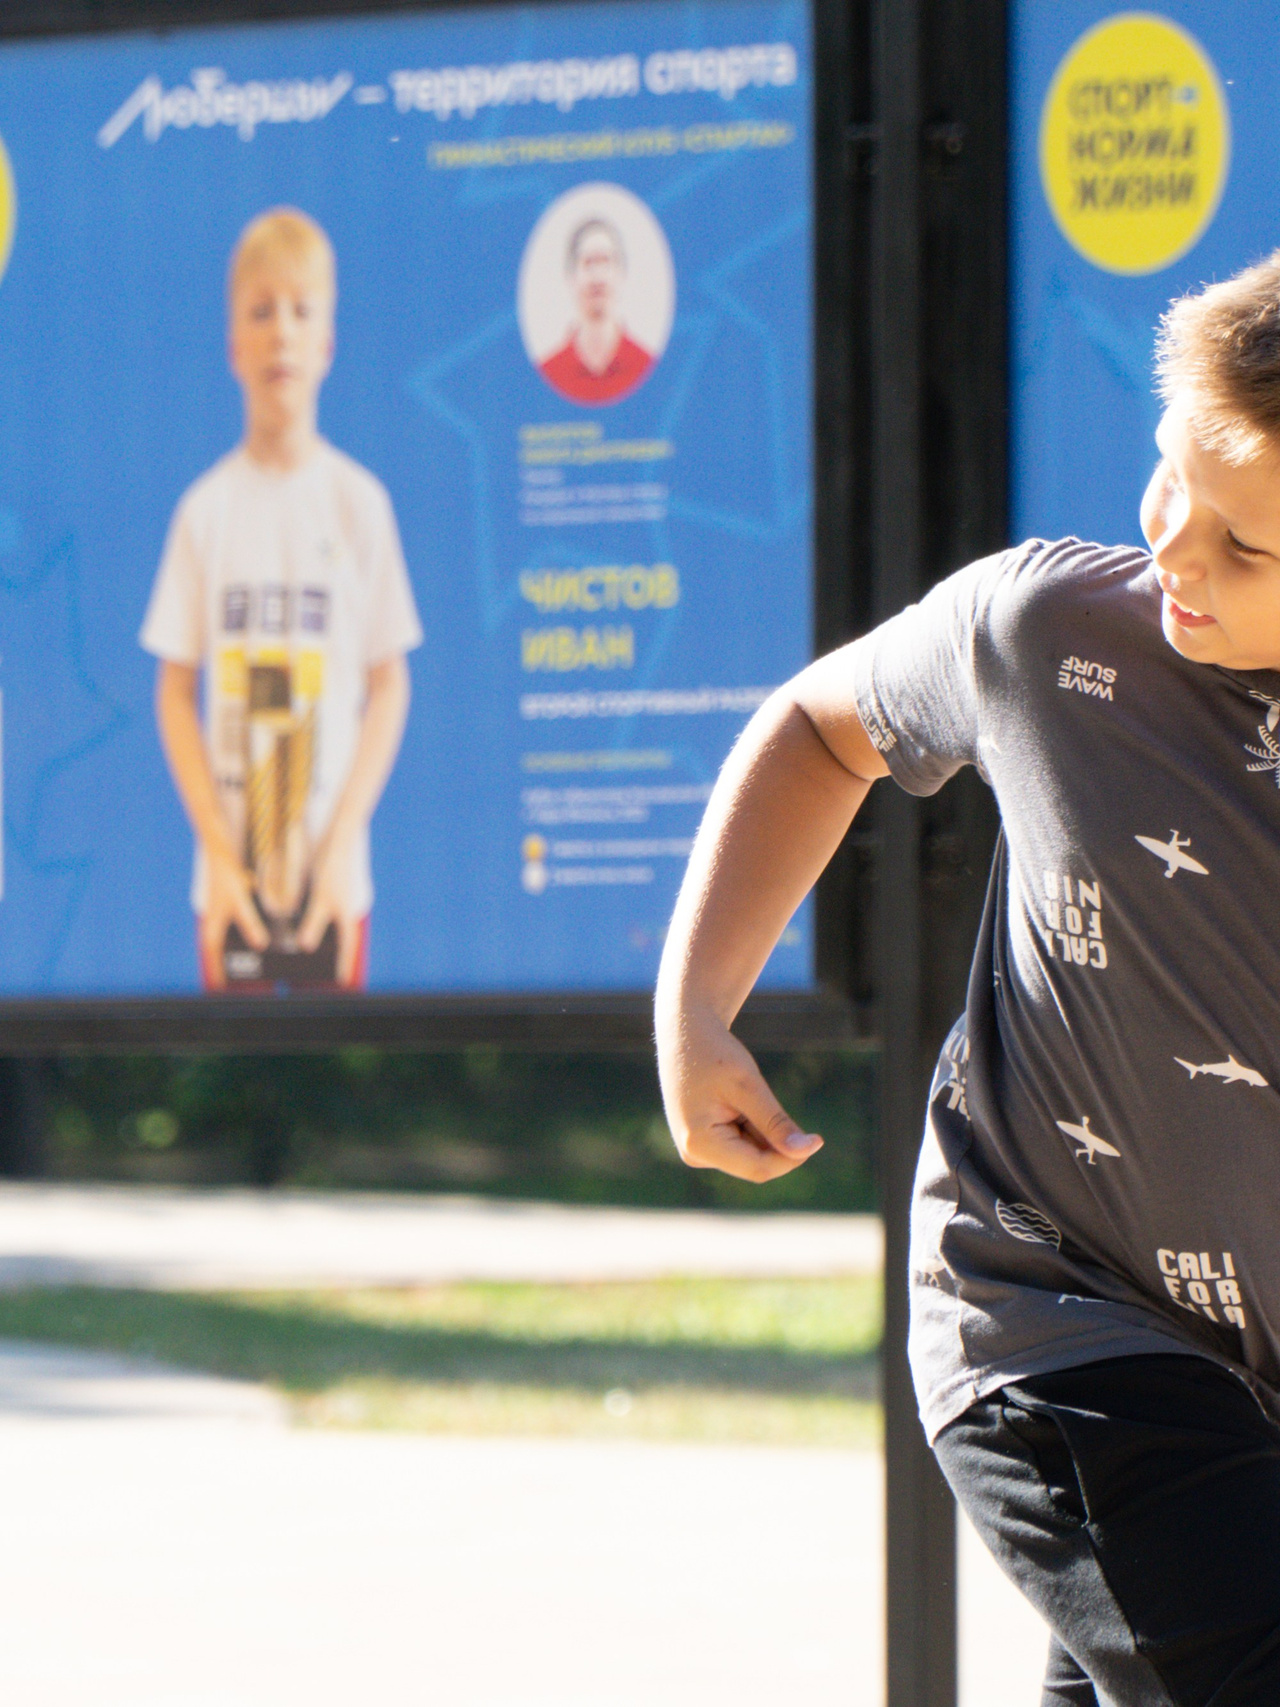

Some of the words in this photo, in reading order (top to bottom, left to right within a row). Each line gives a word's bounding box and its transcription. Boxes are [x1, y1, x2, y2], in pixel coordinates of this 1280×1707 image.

[389, 53, 640, 121] территория
[643, 42, 798, 101] спорта
[1067, 73, 1171, 122] СПОРТ
[1068, 124, 1196, 166] НОРМА
[1070, 171, 1198, 213] ЖИЗНИ
[519, 563, 681, 612] ЧИСТОВ
[521, 624, 634, 672] ИВАН
[1057, 670, 1114, 701] WAVE
[1060, 655, 1118, 684] SURF
[1044, 899, 1103, 940] FOR
[1044, 929, 1108, 970] CALI
[1156, 1248, 1236, 1280] CALI
[1163, 1275, 1242, 1305] FOR
